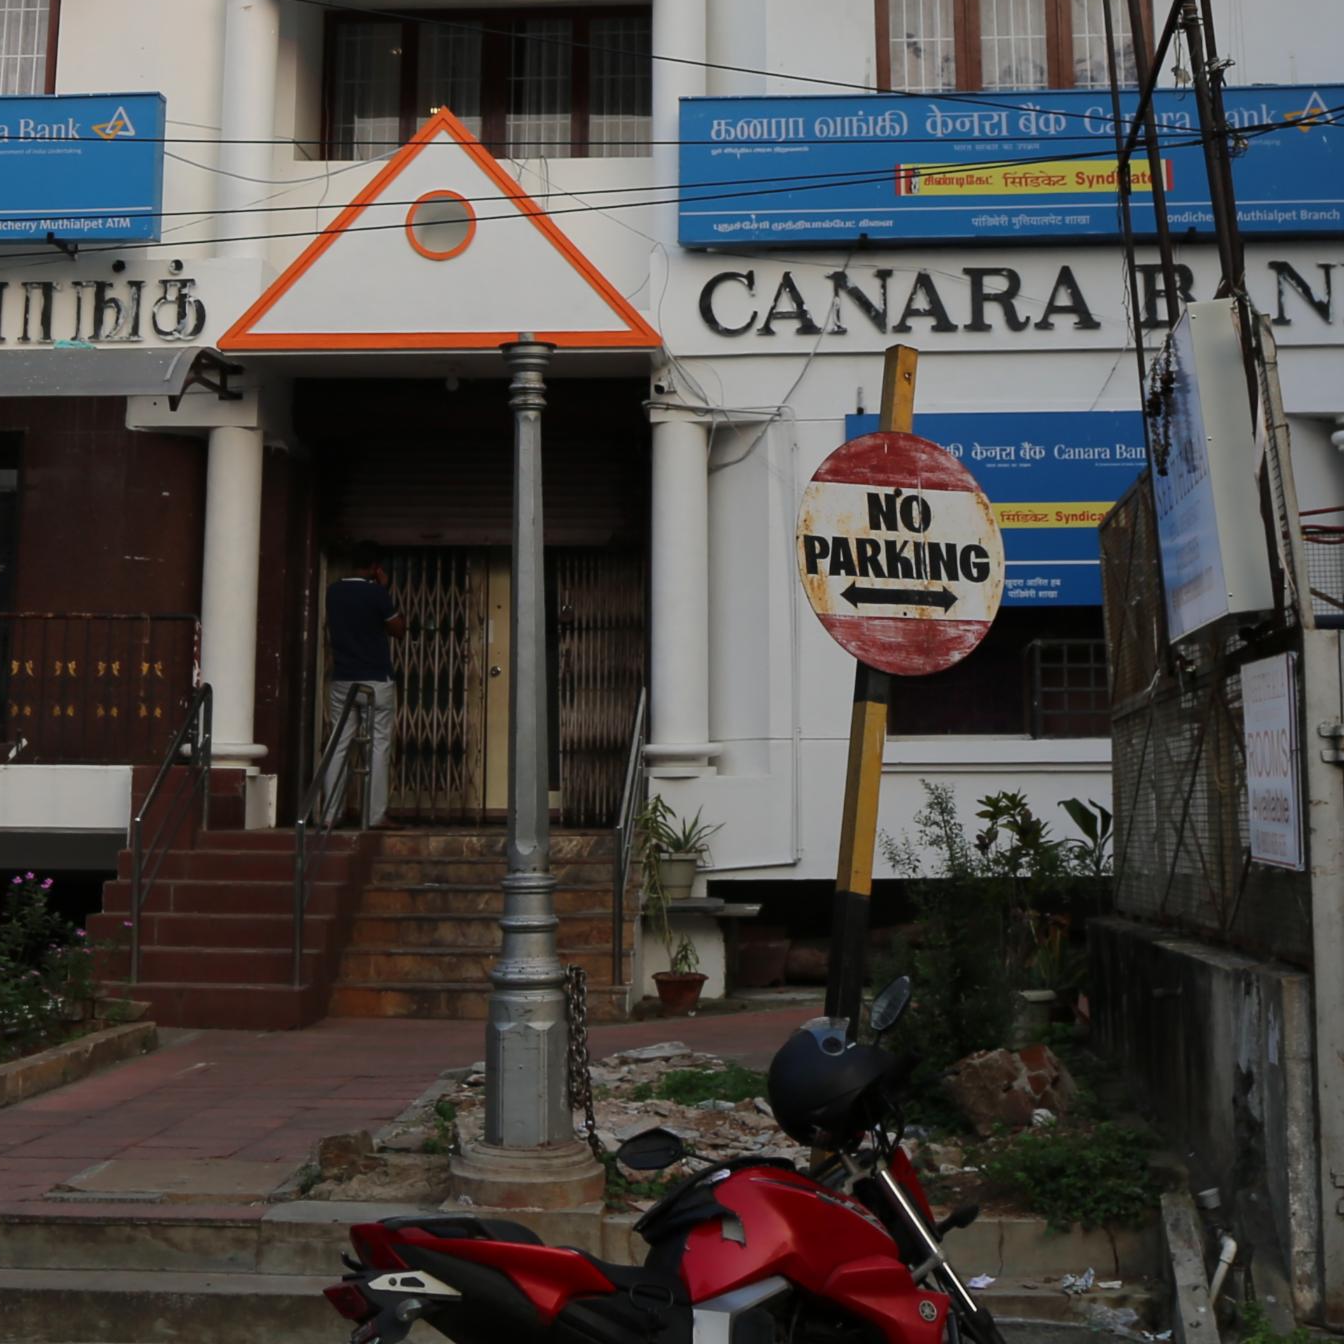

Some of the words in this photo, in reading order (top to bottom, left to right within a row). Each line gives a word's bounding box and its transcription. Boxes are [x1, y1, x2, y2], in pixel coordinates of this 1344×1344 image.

[710, 117, 805, 141] கனரா
[814, 110, 909, 138] வங்கி
[925, 105, 1009, 138] केनरा
[1018, 102, 1067, 135] बैंक
[1225, 104, 1276, 130] ank
[19, 118, 82, 143] Bank
[1002, 170, 1067, 189] सिंडिकेट
[39, 218, 103, 232] Muthialpet
[106, 217, 131, 228] ATM
[1300, 209, 1341, 221] Branch
[698, 266, 1101, 337] CANARA
[971, 442, 1015, 461] केनरा
[1019, 441, 1045, 459] बैंक
[1054, 444, 1110, 460] Canara
[1115, 443, 1148, 460] Ban
[866, 492, 932, 534] NO
[803, 534, 991, 584] PARKING
[1247, 727, 1290, 779] ROOMS
